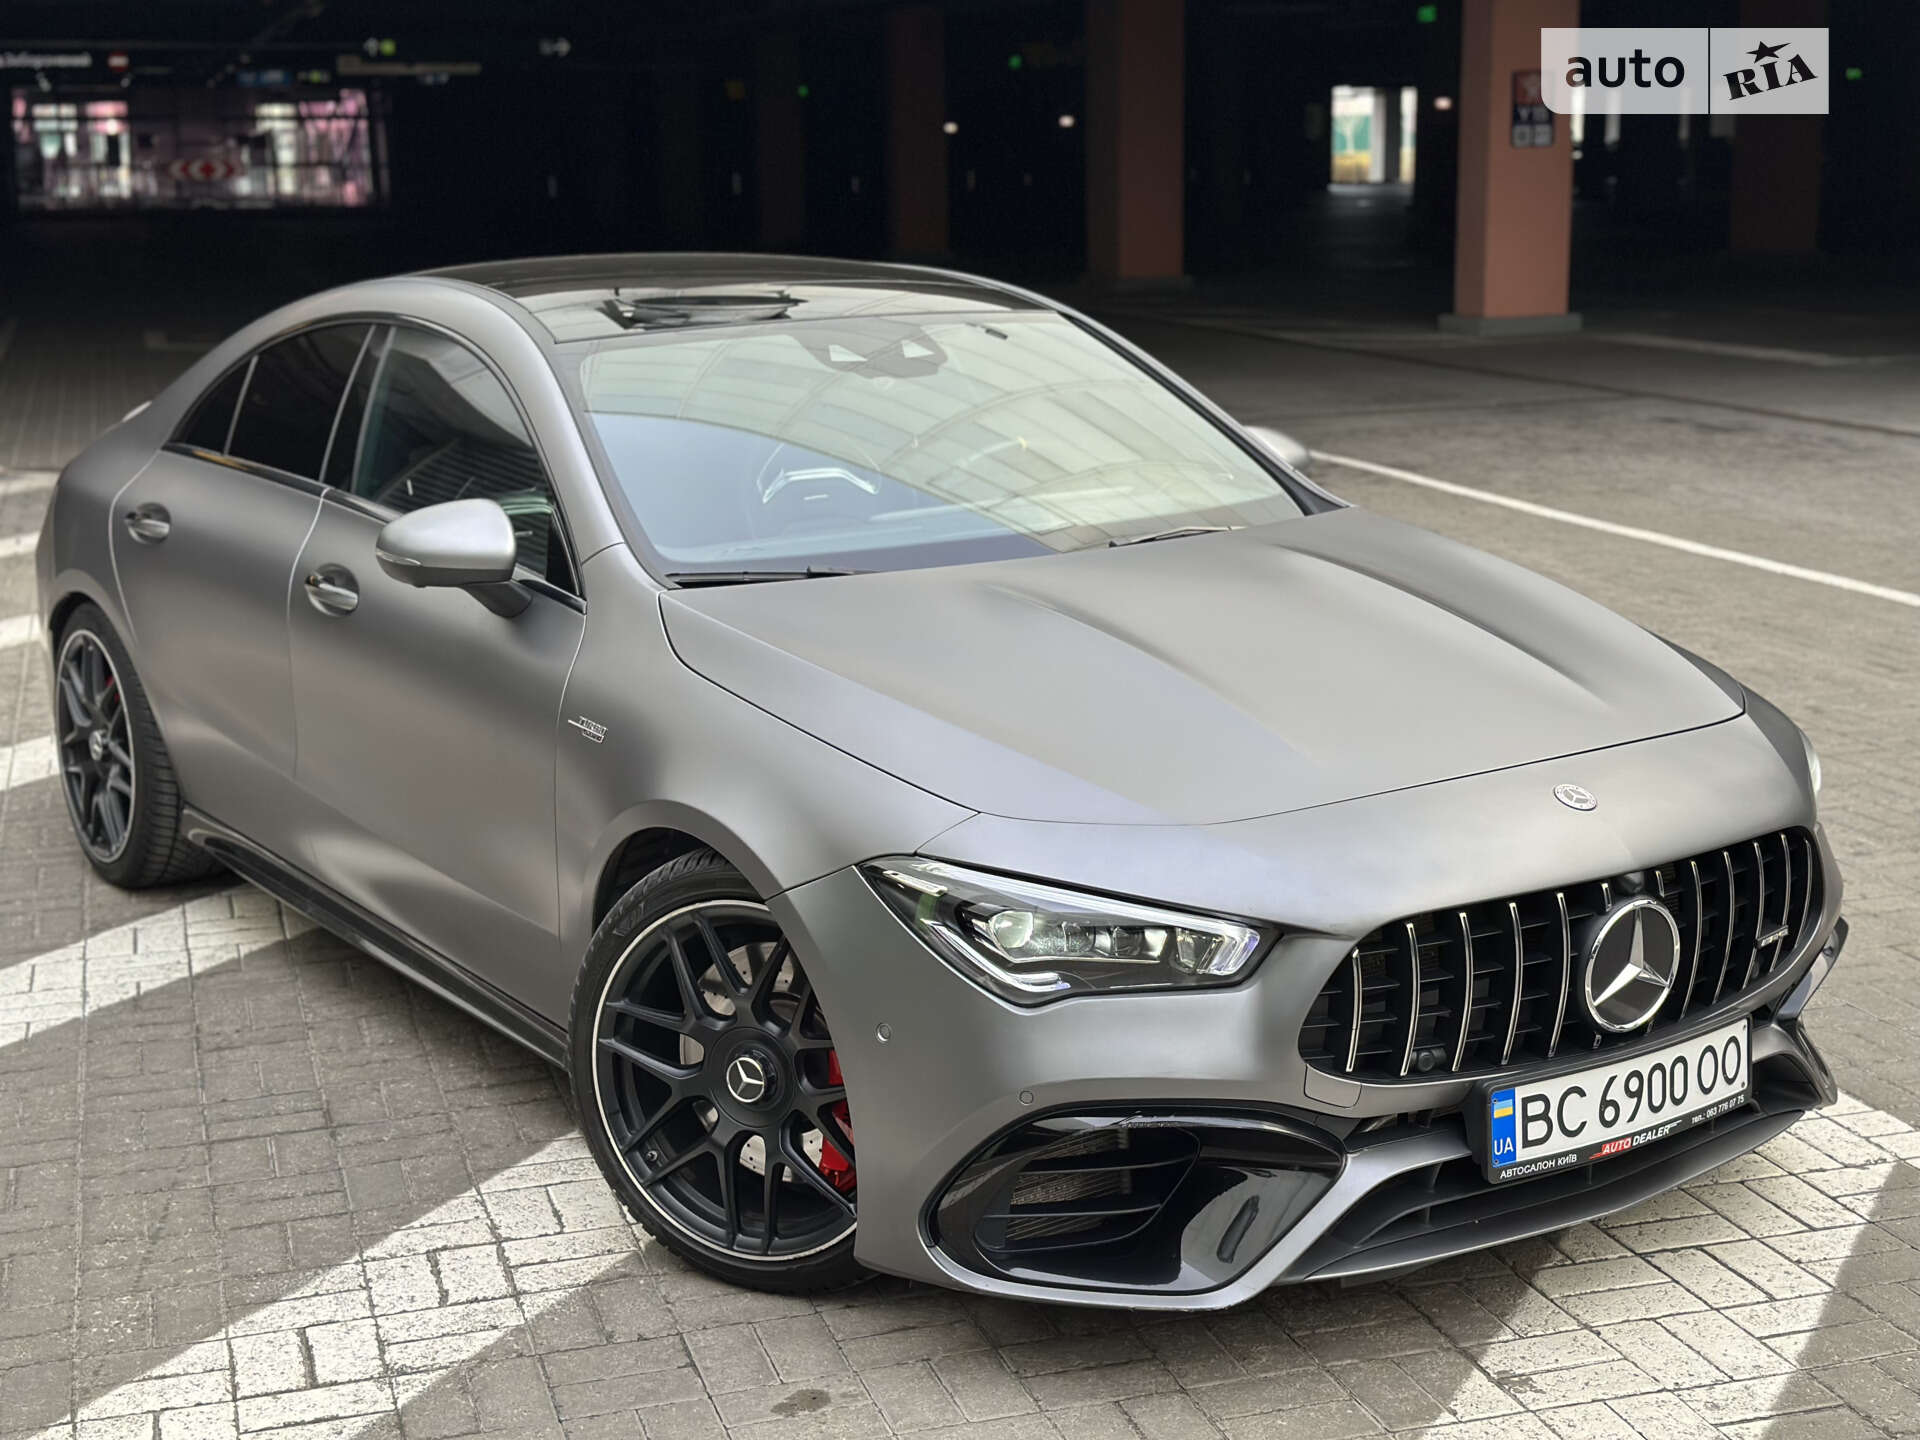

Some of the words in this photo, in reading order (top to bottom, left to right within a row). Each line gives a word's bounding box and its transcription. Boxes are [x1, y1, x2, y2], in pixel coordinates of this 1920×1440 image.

[1521, 1085, 1587, 1149] BC
[1598, 1055, 1689, 1128] 6900
[1494, 1137, 1514, 1155] UA
[1602, 1137, 1632, 1155] AUTO
[1632, 1125, 1671, 1146] DEALER
[1500, 1159, 1556, 1179] АВТОСАЛОН
[1557, 1153, 1578, 1167] КИЇВ
